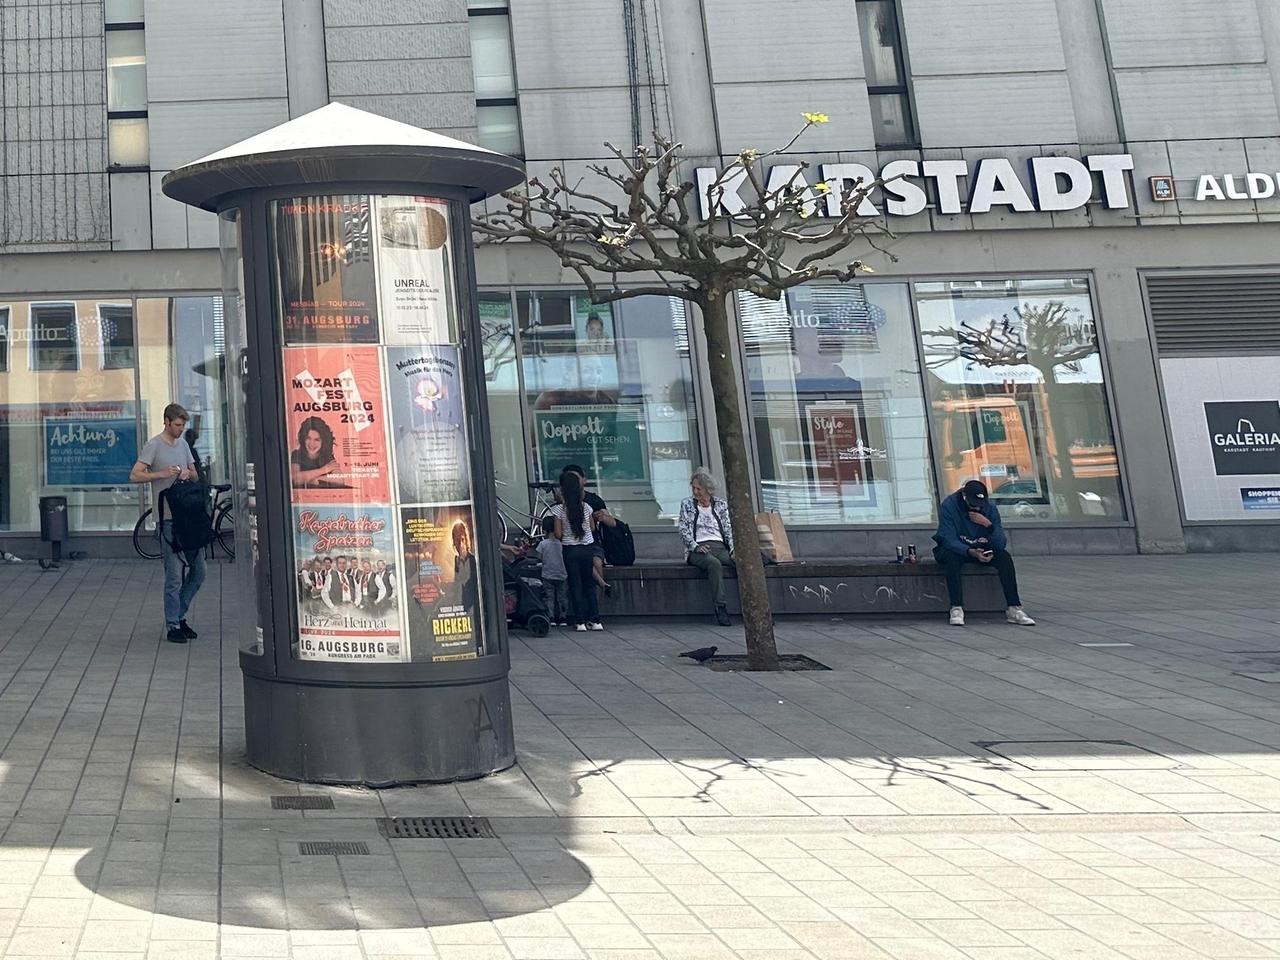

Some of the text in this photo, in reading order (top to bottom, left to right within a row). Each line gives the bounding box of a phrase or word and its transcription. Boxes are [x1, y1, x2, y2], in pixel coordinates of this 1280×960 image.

[696, 154, 1136, 221] KARSTADT
[1196, 172, 1280, 201] ALD
[394, 279, 430, 288] UNREAL
[303, 315, 370, 325] AUGSBURG
[292, 377, 353, 389] MOZART
[317, 390, 354, 400] FEST
[293, 401, 373, 412] AUGSBURG
[340, 413, 376, 424] 2024
[541, 415, 605, 444] Doppelt
[814, 416, 845, 435] Style
[586, 435, 630, 444] GUT SEHEN
[1214, 433, 1280, 446] GALERIA
[313, 527, 373, 553] Spatzen
[304, 615, 330, 628] Herz
[344, 616, 388, 632] Heimat
[432, 616, 473, 636] RICKERL
[300, 640, 385, 653] 16. AUGSBURG
